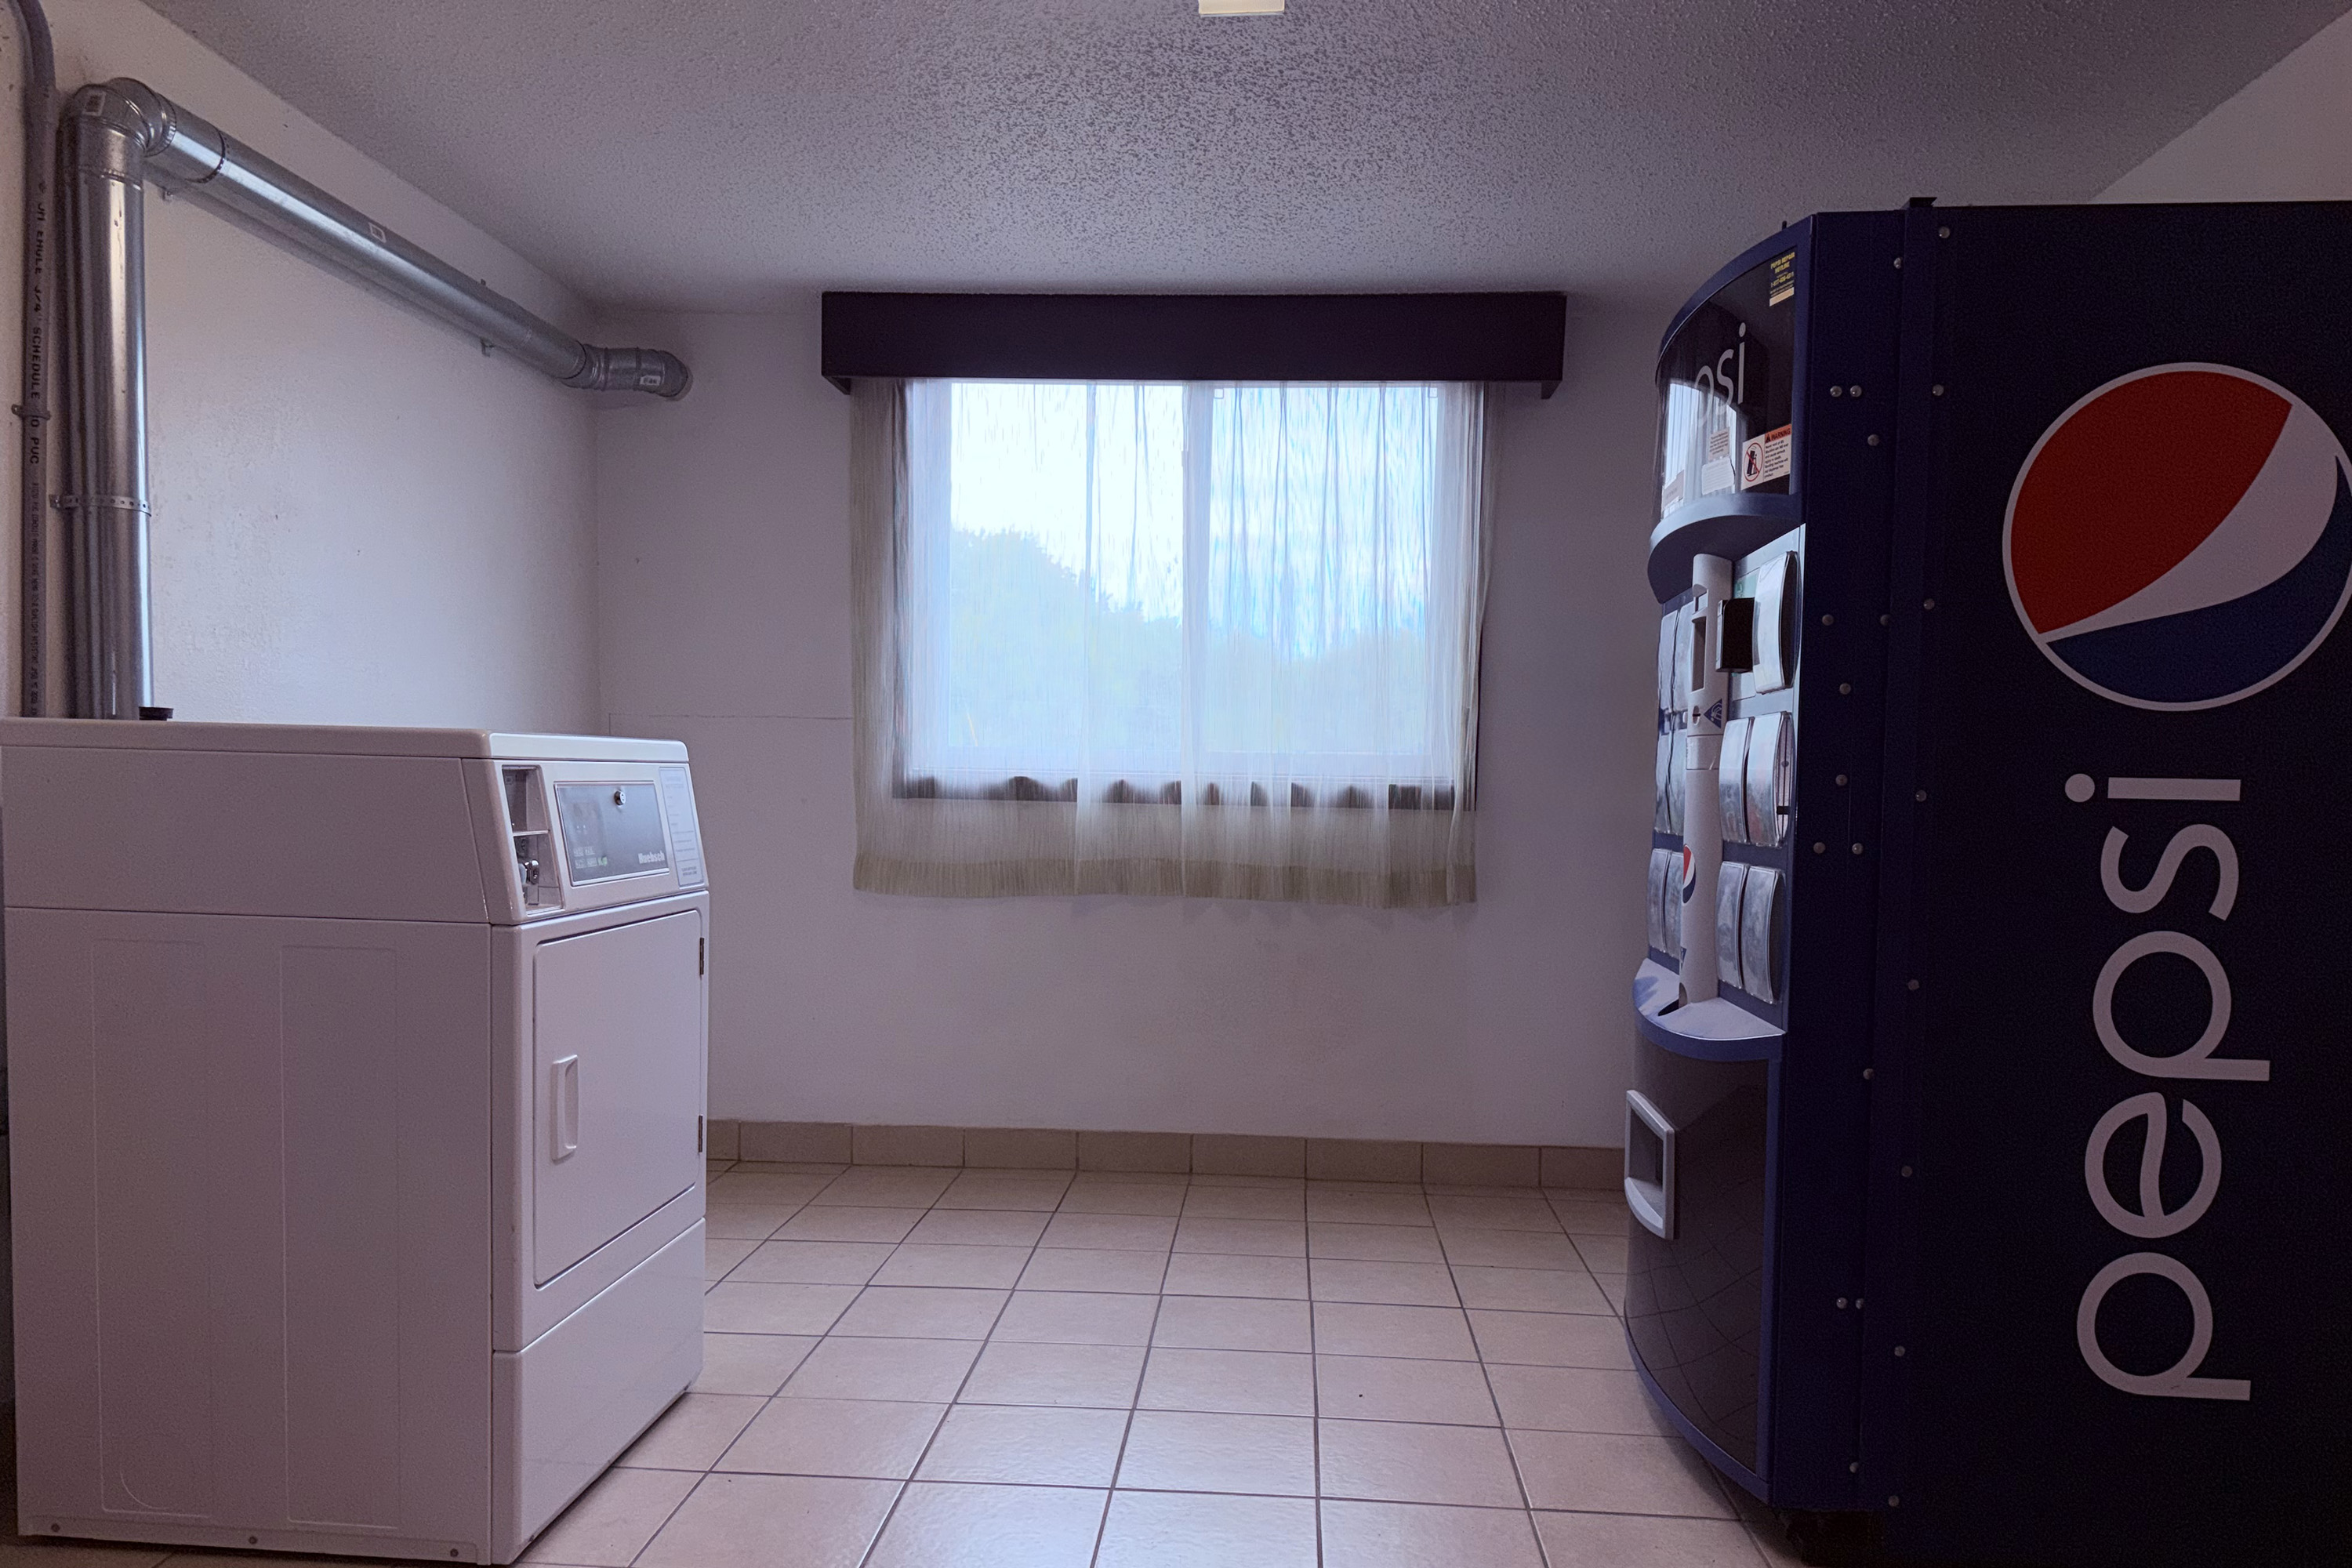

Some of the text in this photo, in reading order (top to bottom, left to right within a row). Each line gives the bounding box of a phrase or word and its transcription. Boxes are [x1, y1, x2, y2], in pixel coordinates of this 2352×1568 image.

[31, 326, 42, 399] SCHEDULE
[1771, 428, 1791, 441] WARNING
[2063, 772, 2270, 1402] pepsi
